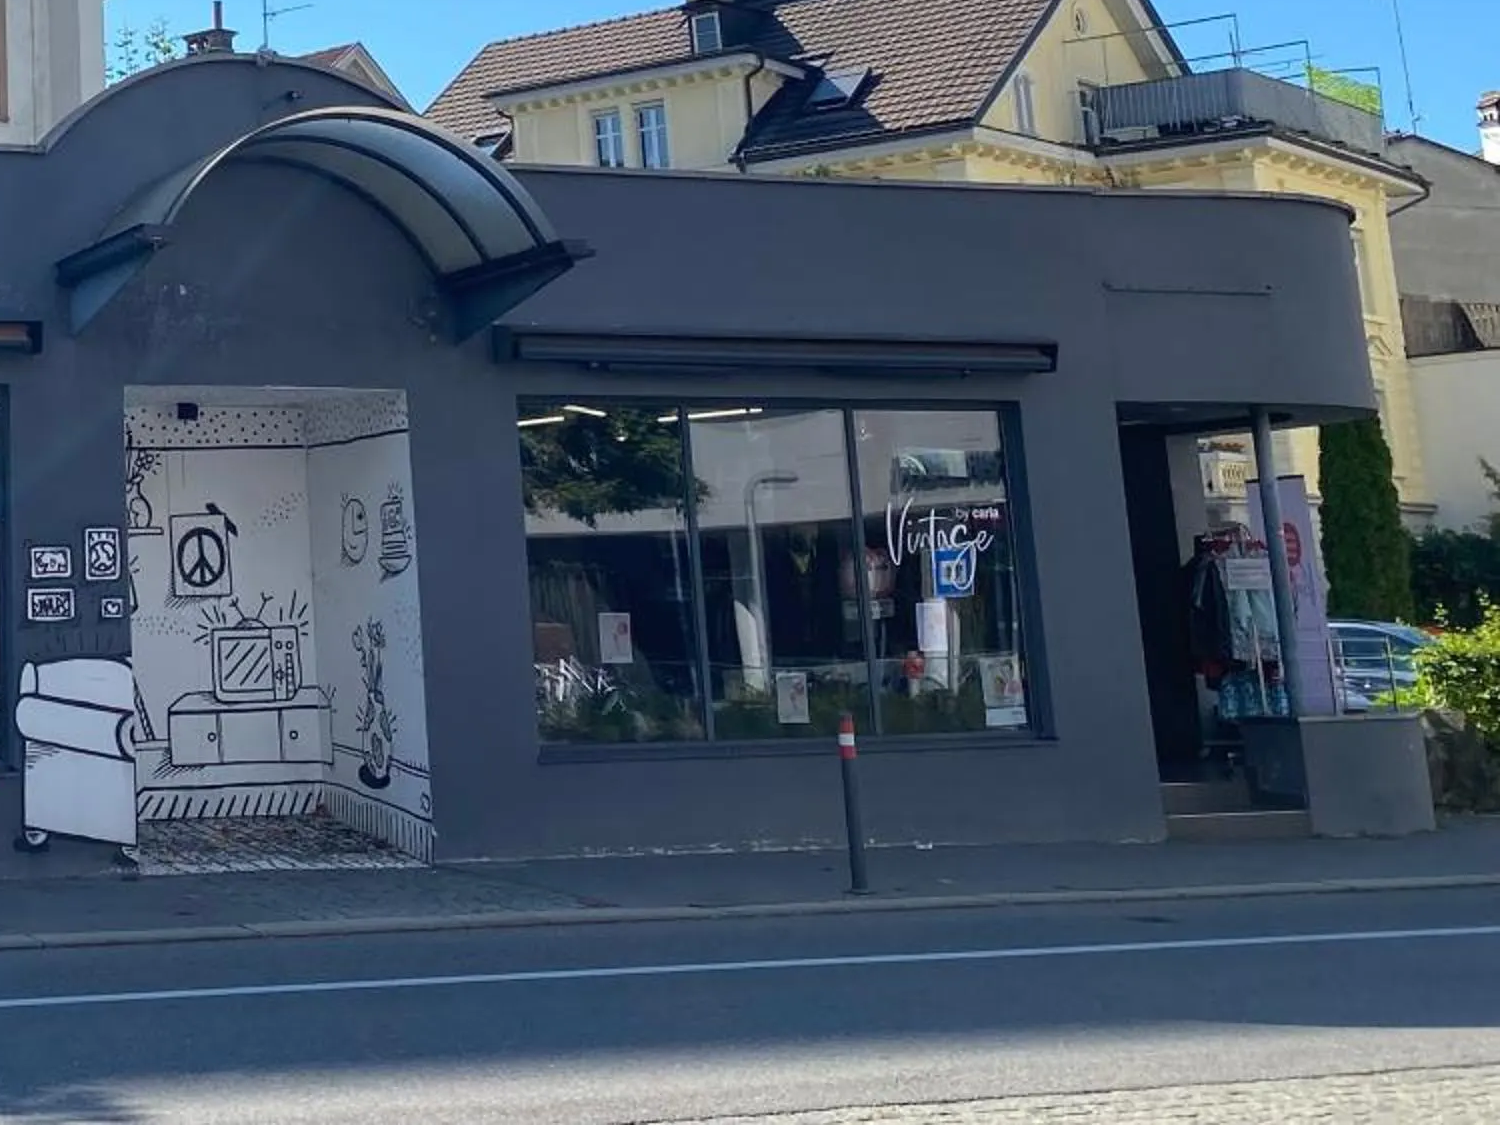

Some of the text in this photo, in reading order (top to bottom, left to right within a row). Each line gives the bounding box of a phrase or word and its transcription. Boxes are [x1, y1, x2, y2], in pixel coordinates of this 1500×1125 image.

[956, 507, 1000, 522] by carla
[886, 496, 994, 590] Vintage
